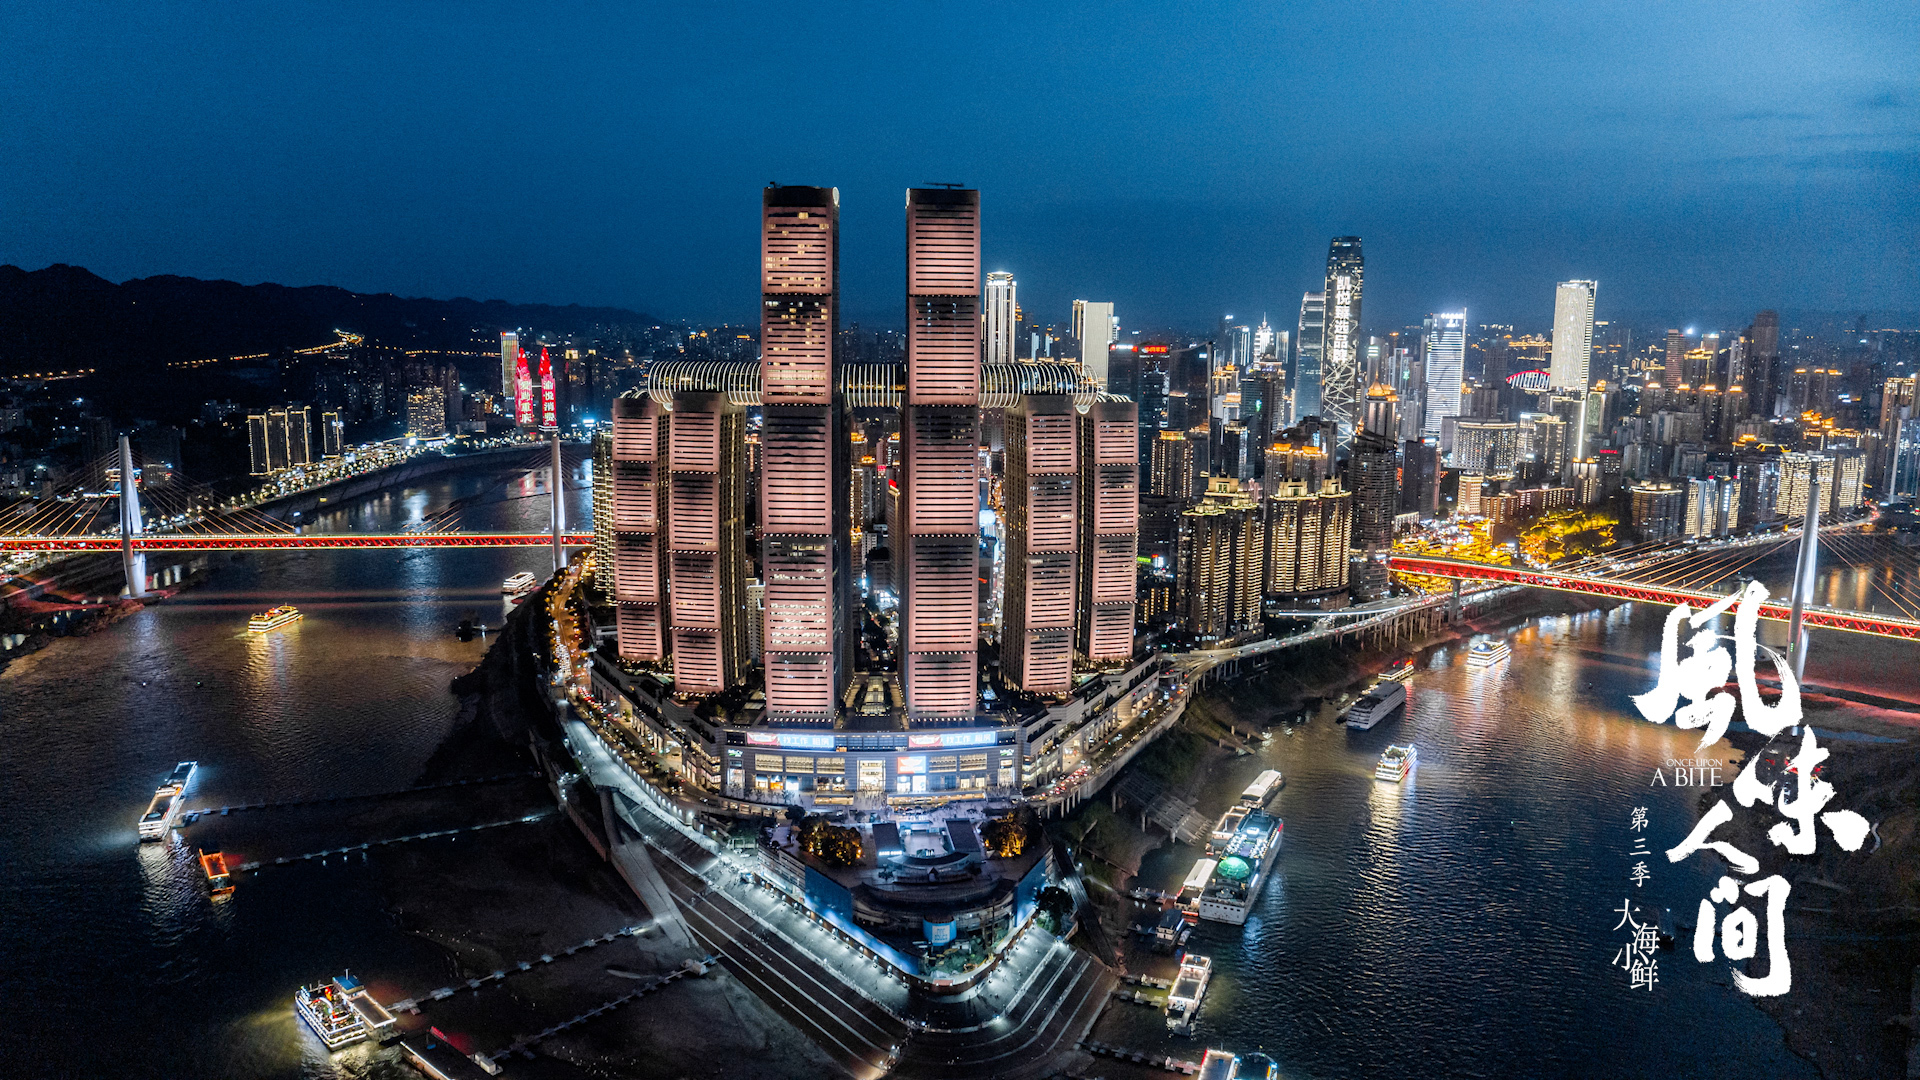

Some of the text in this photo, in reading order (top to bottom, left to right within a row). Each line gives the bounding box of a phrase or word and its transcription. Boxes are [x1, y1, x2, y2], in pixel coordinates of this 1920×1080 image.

[783, 736, 808, 745] 找工作
[946, 735, 971, 744] 找工作
